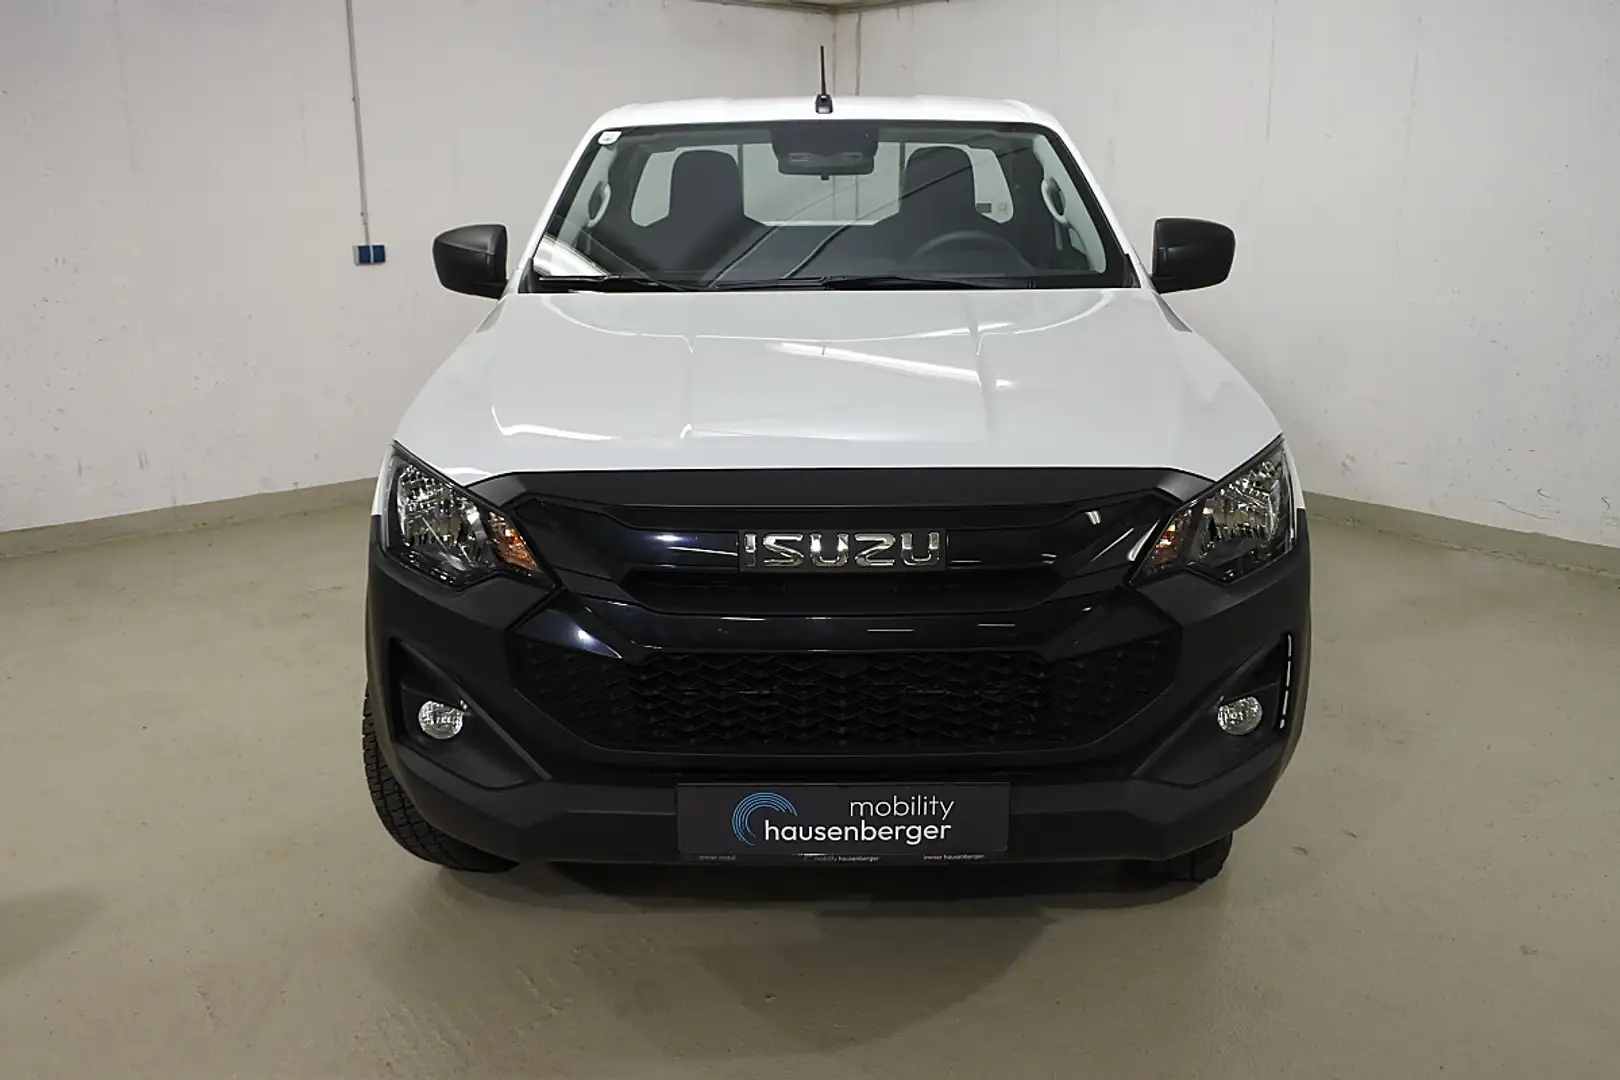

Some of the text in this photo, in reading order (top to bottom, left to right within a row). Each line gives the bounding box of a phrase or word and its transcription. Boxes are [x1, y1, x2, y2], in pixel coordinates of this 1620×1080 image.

[744, 532, 940, 567] ISUZU
[849, 795, 955, 820] mobility
[764, 819, 952, 845] hausenberger
